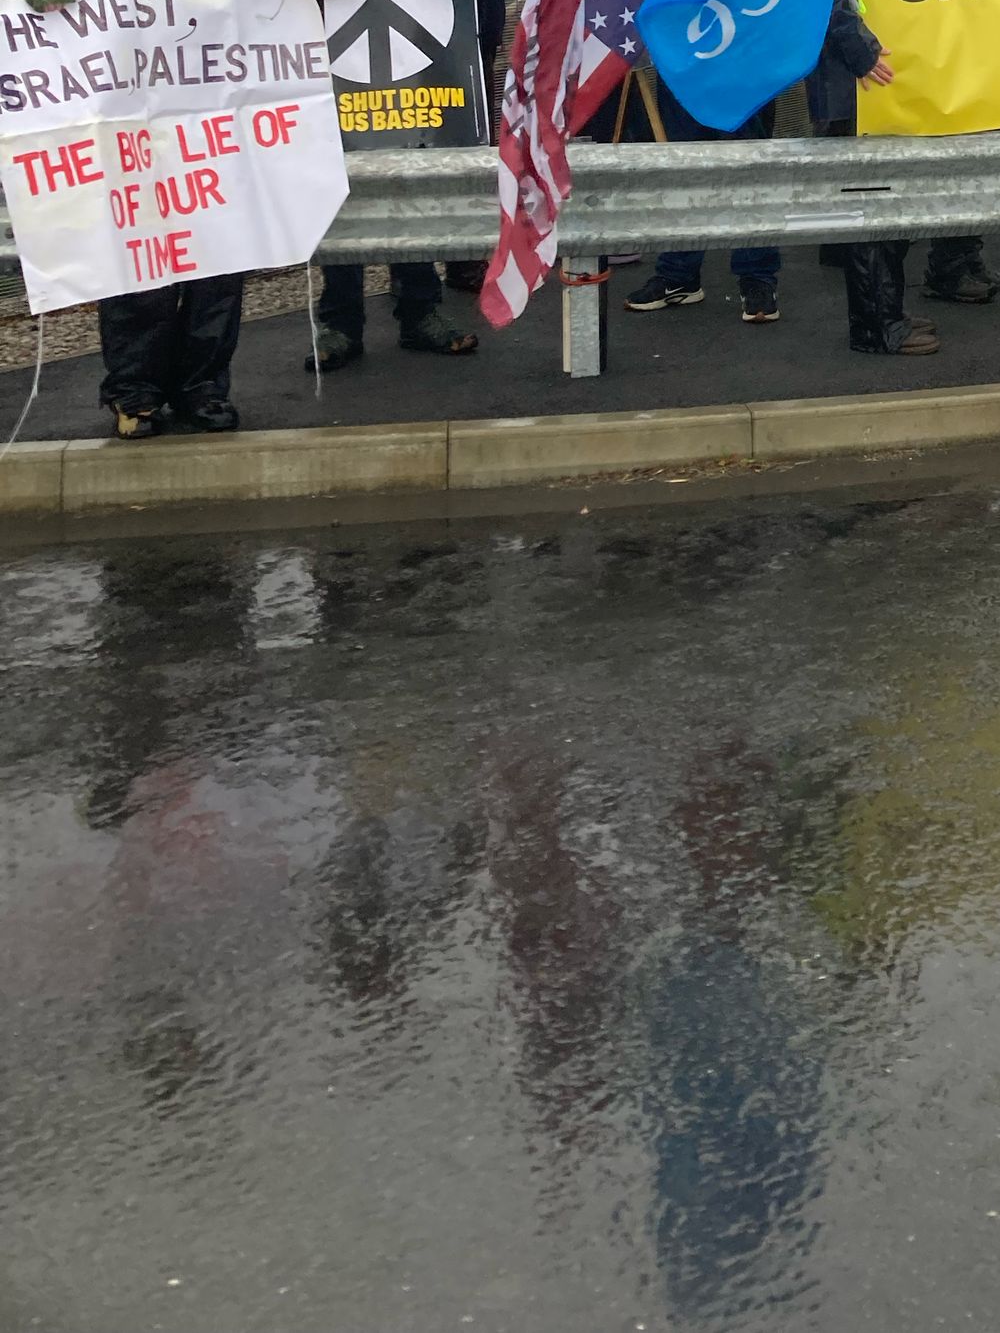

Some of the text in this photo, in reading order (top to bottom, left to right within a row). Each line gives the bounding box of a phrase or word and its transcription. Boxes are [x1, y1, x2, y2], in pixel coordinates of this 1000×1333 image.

[1, 13, 59, 52] HE
[339, 87, 465, 113] SHUT DOWN
[340, 107, 443, 132] US BASES
[13, 104, 300, 196] THE BIG LIE OF
[110, 168, 227, 230] OF OUR
[126, 231, 197, 282] TIME
